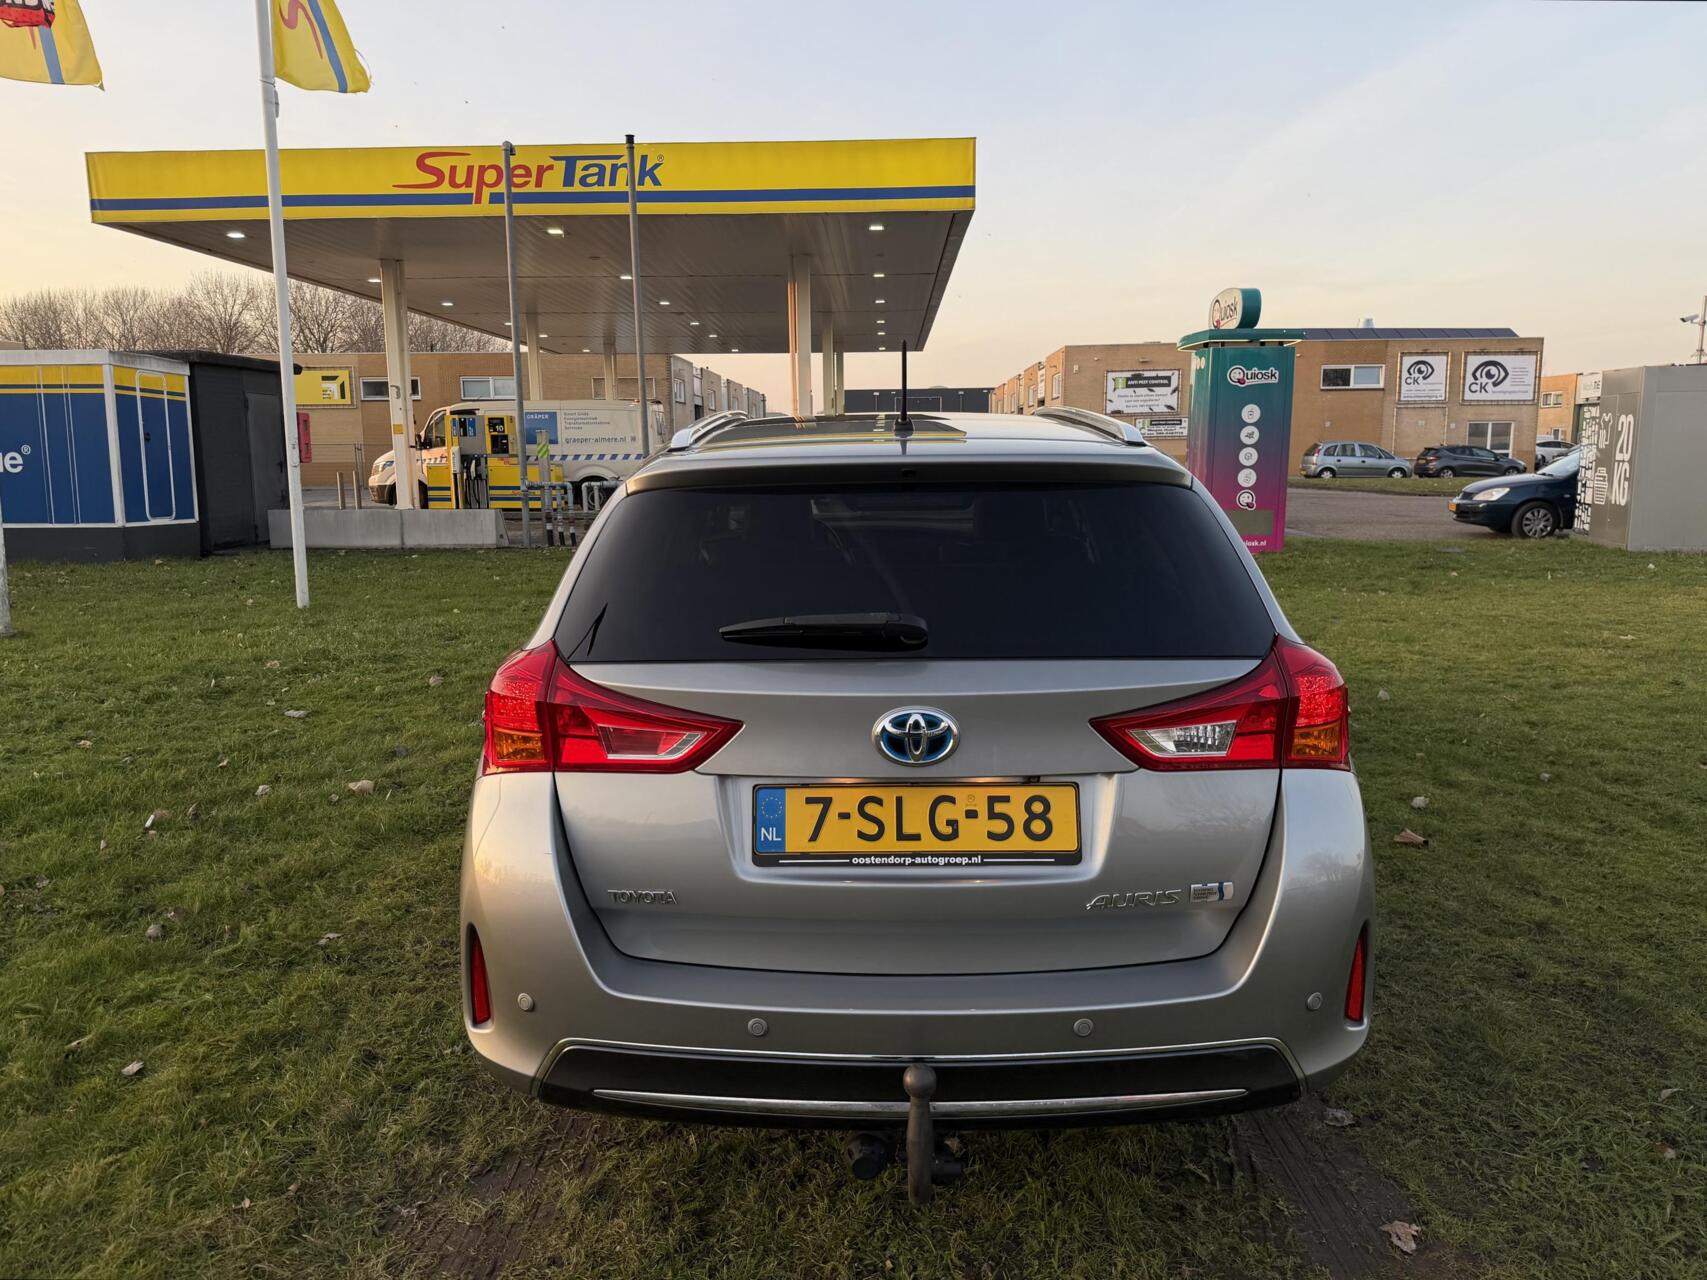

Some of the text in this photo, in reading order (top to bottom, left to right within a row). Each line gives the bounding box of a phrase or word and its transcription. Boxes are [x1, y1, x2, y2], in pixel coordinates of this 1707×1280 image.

[1212, 296, 1238, 329] Quiosk
[1228, 366, 1278, 385] Quiosk
[1405, 376, 1420, 386] CK
[1468, 382, 1489, 393] CK
[1615, 414, 1634, 462] 20
[1611, 461, 1630, 507] KG
[804, 794, 1054, 843] 7-SLG-58
[760, 827, 783, 842] NL
[851, 855, 982, 866] oostendorp-autogroep.nl
[607, 889, 678, 905] TOYOTA
[1086, 888, 1182, 911] AURIS
